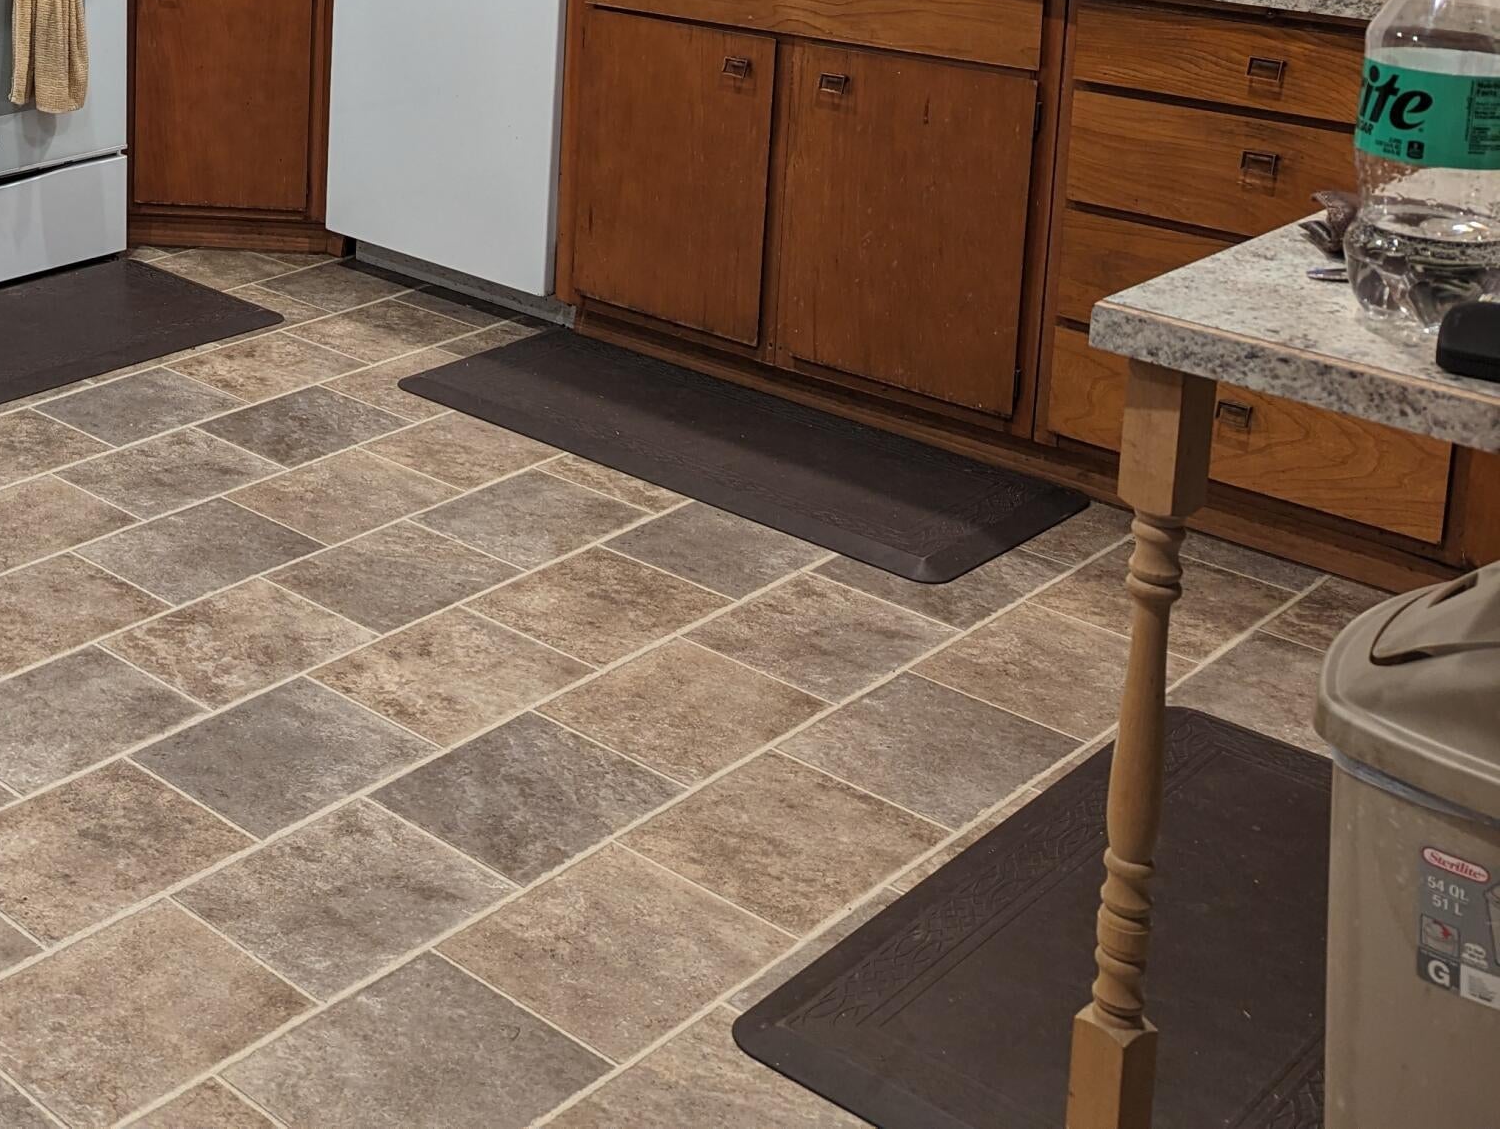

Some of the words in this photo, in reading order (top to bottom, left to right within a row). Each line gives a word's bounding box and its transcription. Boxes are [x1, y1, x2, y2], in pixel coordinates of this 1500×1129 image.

[1430, 850, 1487, 880] Sterilite
[1427, 875, 1445, 892] 54
[1432, 894, 1449, 911] 51
[1454, 903, 1463, 916] L
[1427, 959, 1451, 987] G
